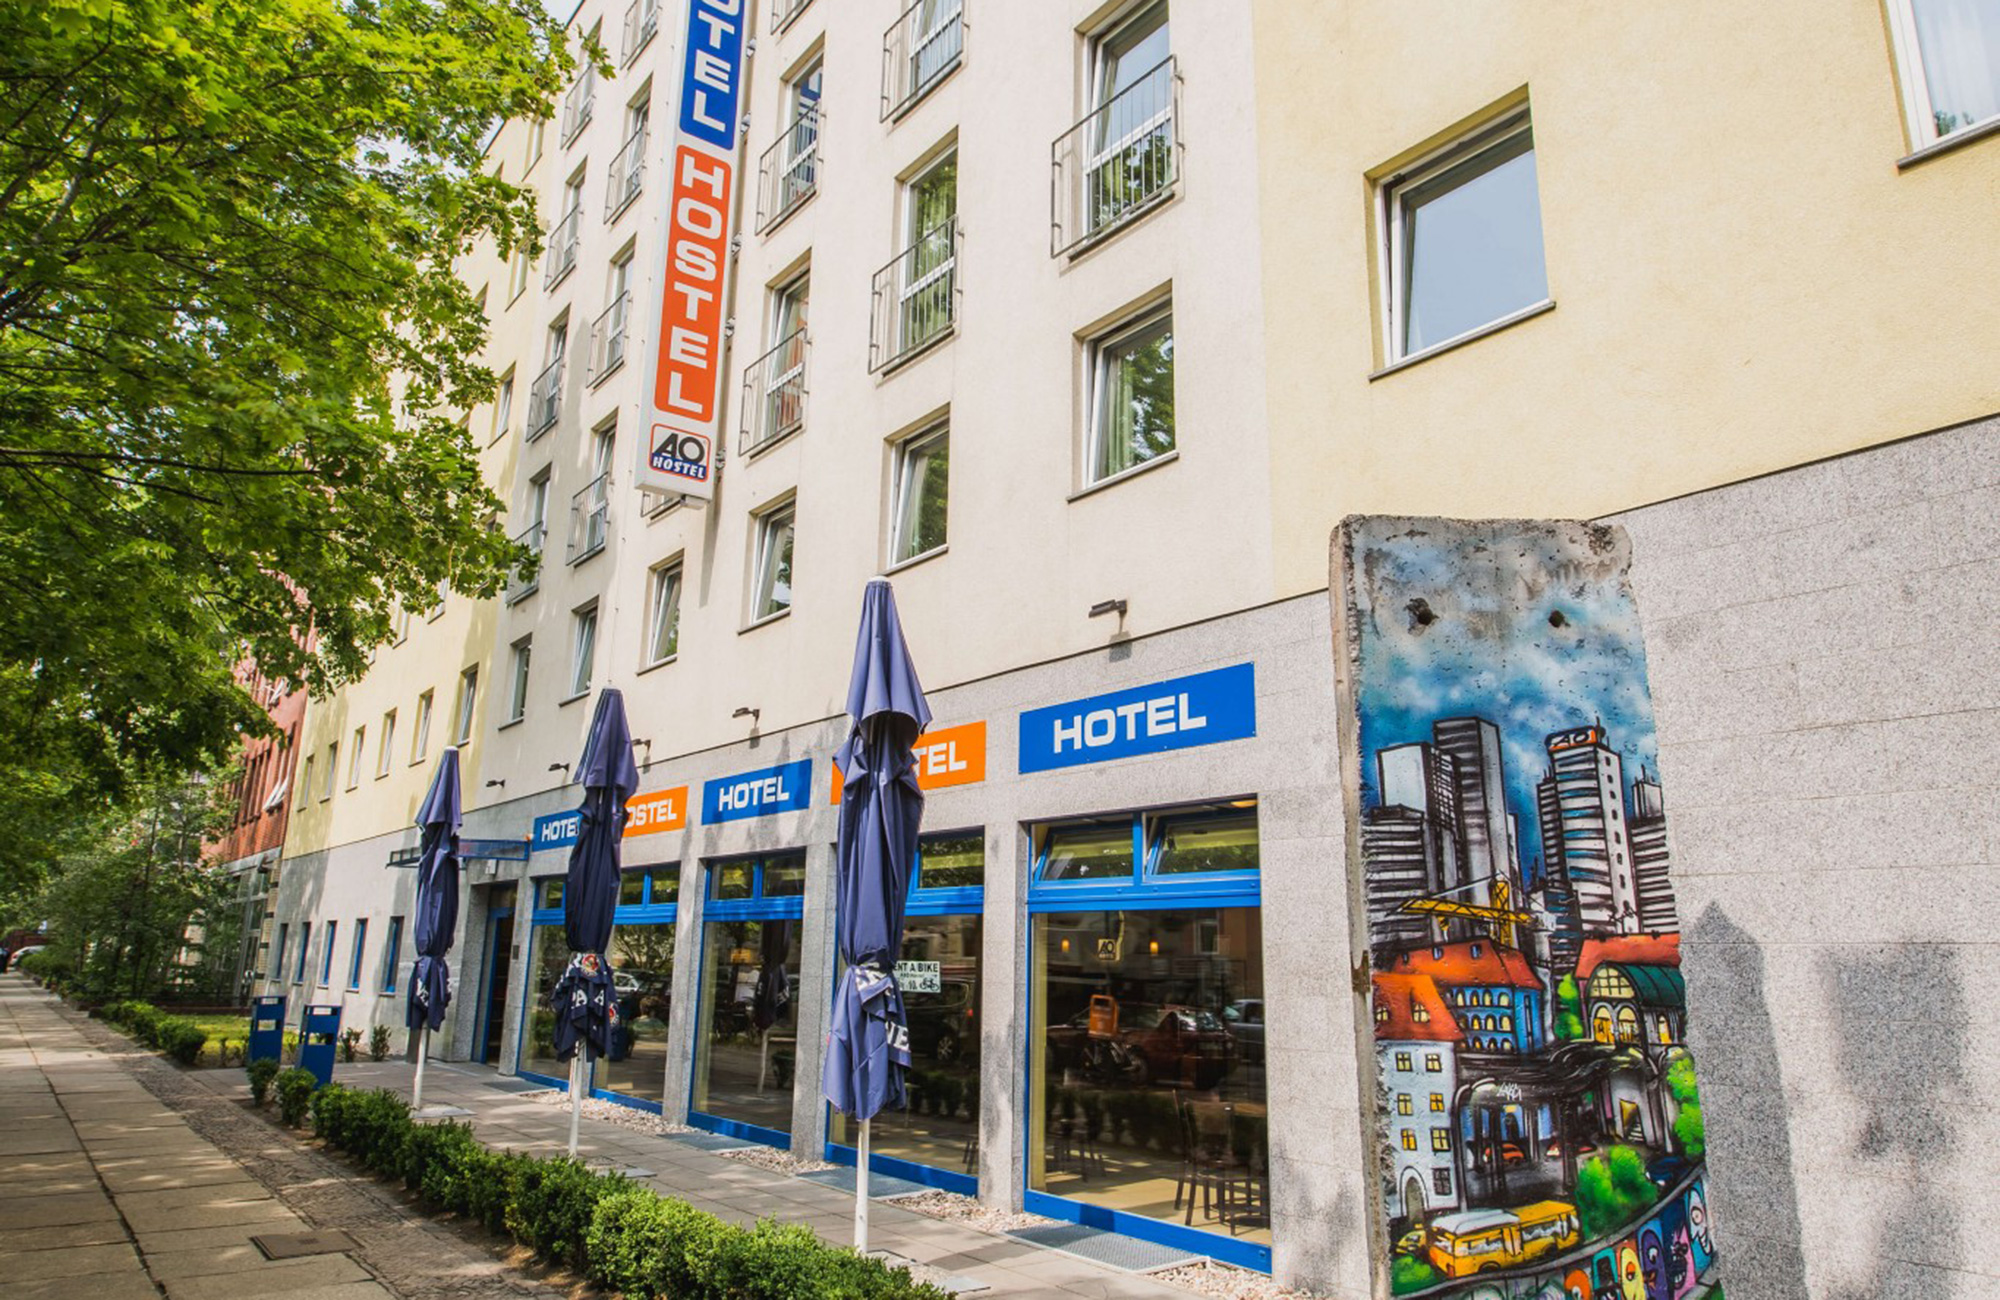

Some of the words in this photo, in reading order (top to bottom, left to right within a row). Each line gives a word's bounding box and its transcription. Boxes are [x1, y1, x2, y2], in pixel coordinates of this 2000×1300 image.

[668, 153, 725, 415] HOSTEL
[653, 432, 705, 464] AO
[652, 456, 705, 480] HOSTEL
[1053, 692, 1207, 754] HOTEL
[910, 740, 968, 777] TEL
[718, 774, 789, 812] HOTEL
[541, 815, 580, 842] HOTE
[625, 798, 677, 828] OSTEL
[917, 962, 939, 973] BIKE
